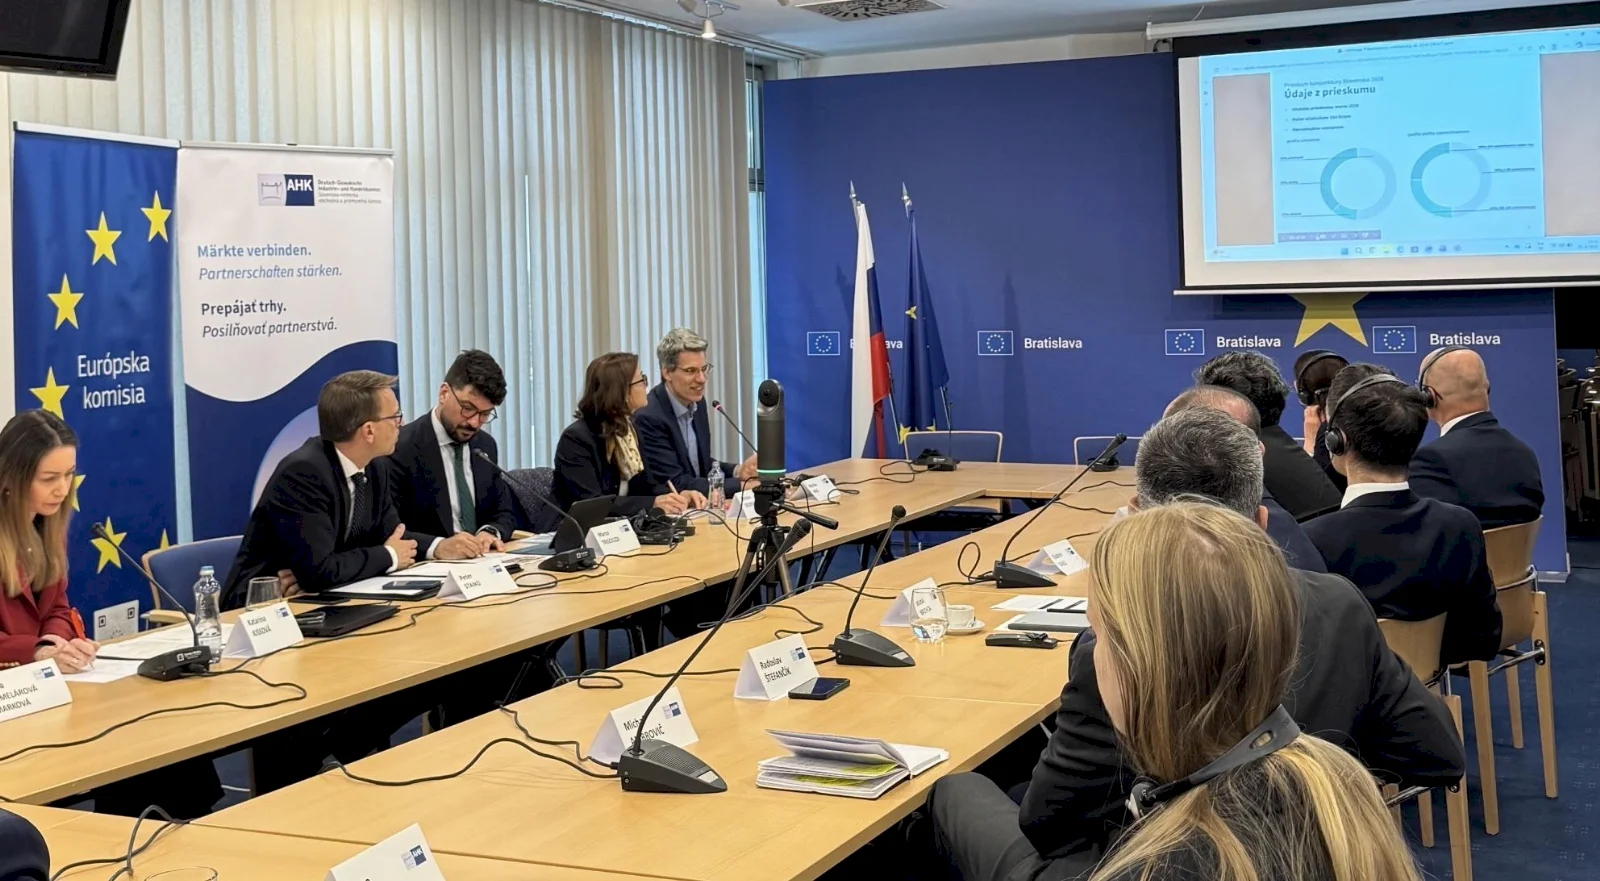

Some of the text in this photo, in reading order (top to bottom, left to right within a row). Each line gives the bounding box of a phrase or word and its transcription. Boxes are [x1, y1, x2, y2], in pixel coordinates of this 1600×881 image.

[1284, 88, 1313, 99] Údaje
[1322, 86, 1376, 98] prieskumu
[287, 179, 313, 192] AHK
[197, 243, 312, 258] Märkte verbinden.
[199, 264, 342, 280] Partnerschaften stärken.
[201, 299, 287, 317] Prepájať trhy.
[202, 316, 338, 338] Posilňovať partnerstvá.
[1024, 337, 1083, 349] Bratislava
[1216, 335, 1282, 348] Bratislava
[1429, 332, 1502, 346] Bratislava
[77, 350, 150, 379] Európska
[83, 383, 146, 409] komisia
[760, 657, 782, 669] Radoslav
[764, 665, 791, 682] ŠTEFANČÍK
[623, 715, 645, 731] Mich
